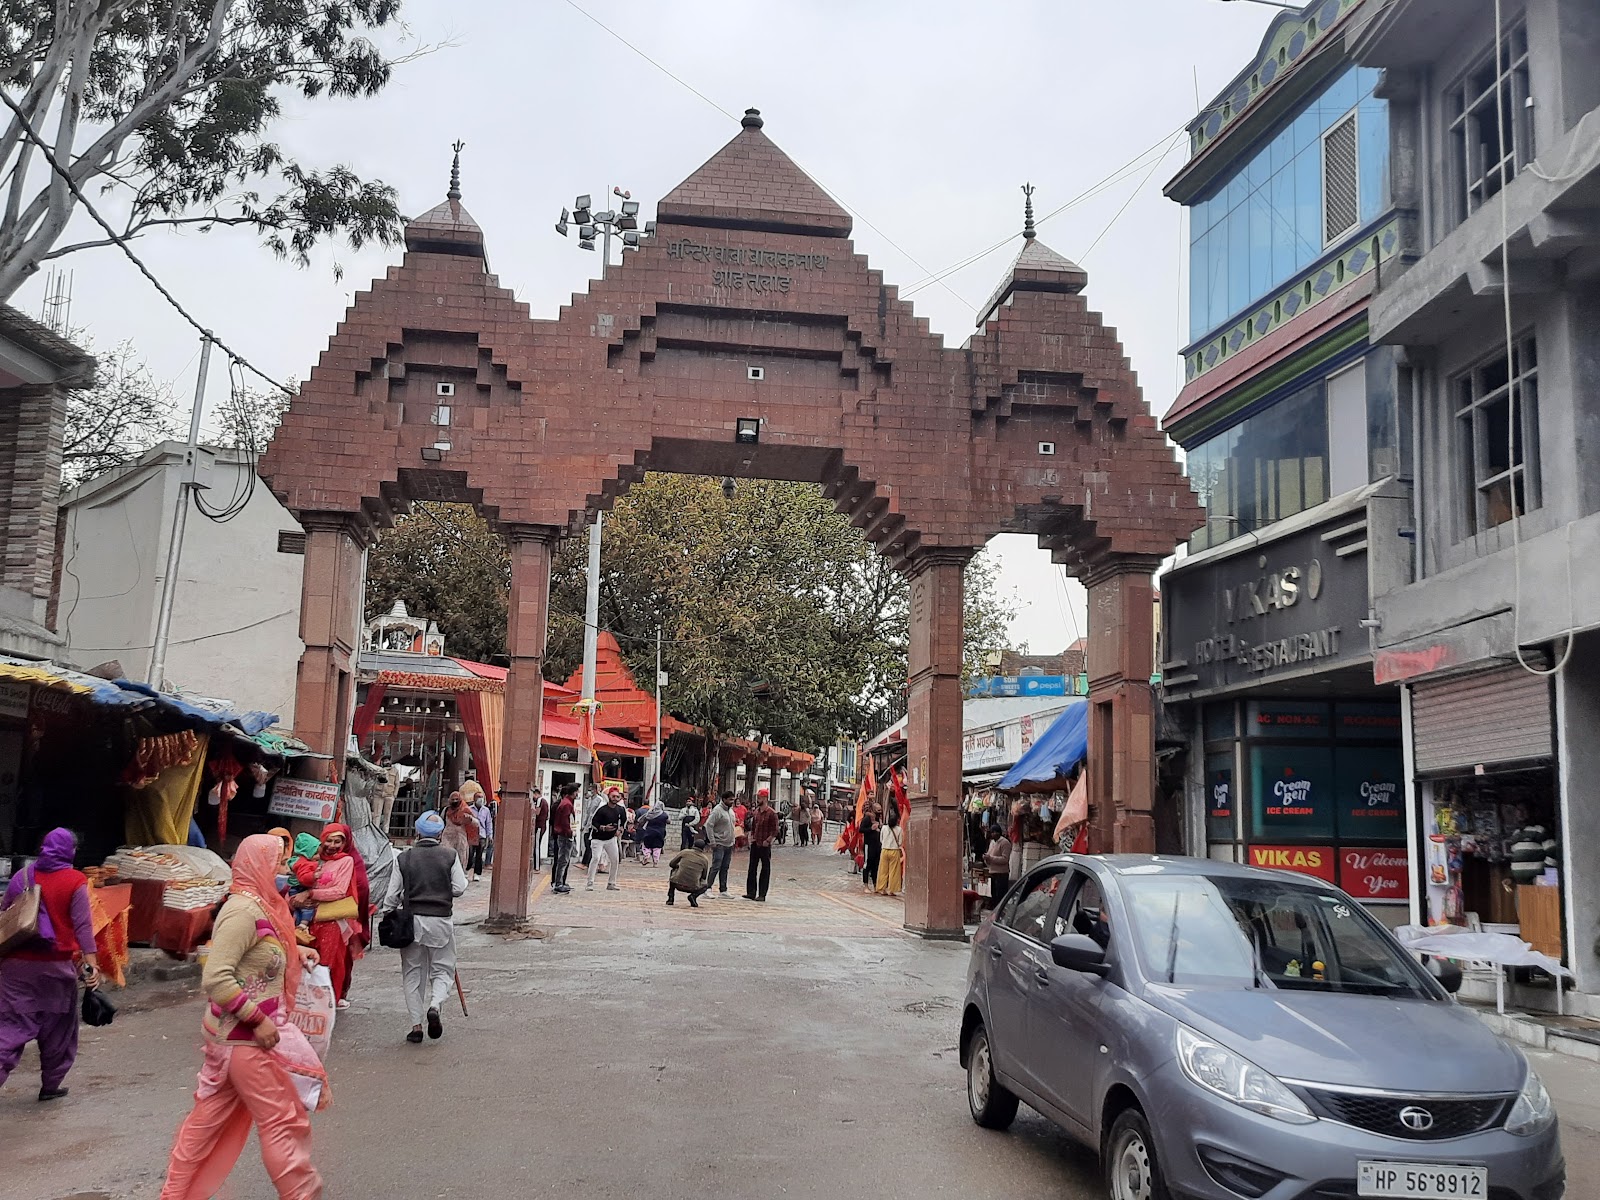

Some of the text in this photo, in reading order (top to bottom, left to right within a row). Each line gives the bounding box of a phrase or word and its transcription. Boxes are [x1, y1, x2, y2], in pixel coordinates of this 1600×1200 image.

[714, 246, 747, 267] बाबा
[712, 269, 744, 290] शाह
[1224, 565, 1301, 624] VIKAS
[1196, 633, 1238, 664] HOTEL
[1248, 626, 1341, 674] RESTAURANT
[1039, 681, 1062, 690] pepsi
[1273, 779, 1311, 797] Cream
[1360, 781, 1396, 798] Cream
[1282, 789, 1307, 806] Bell
[1368, 791, 1390, 806] Bell
[1266, 807, 1314, 815] ICE CREAM
[1254, 849, 1322, 868] VIKAS
[1345, 852, 1409, 870] Welcom
[1363, 875, 1399, 894] You
[1375, 1169, 1397, 1190] HP
